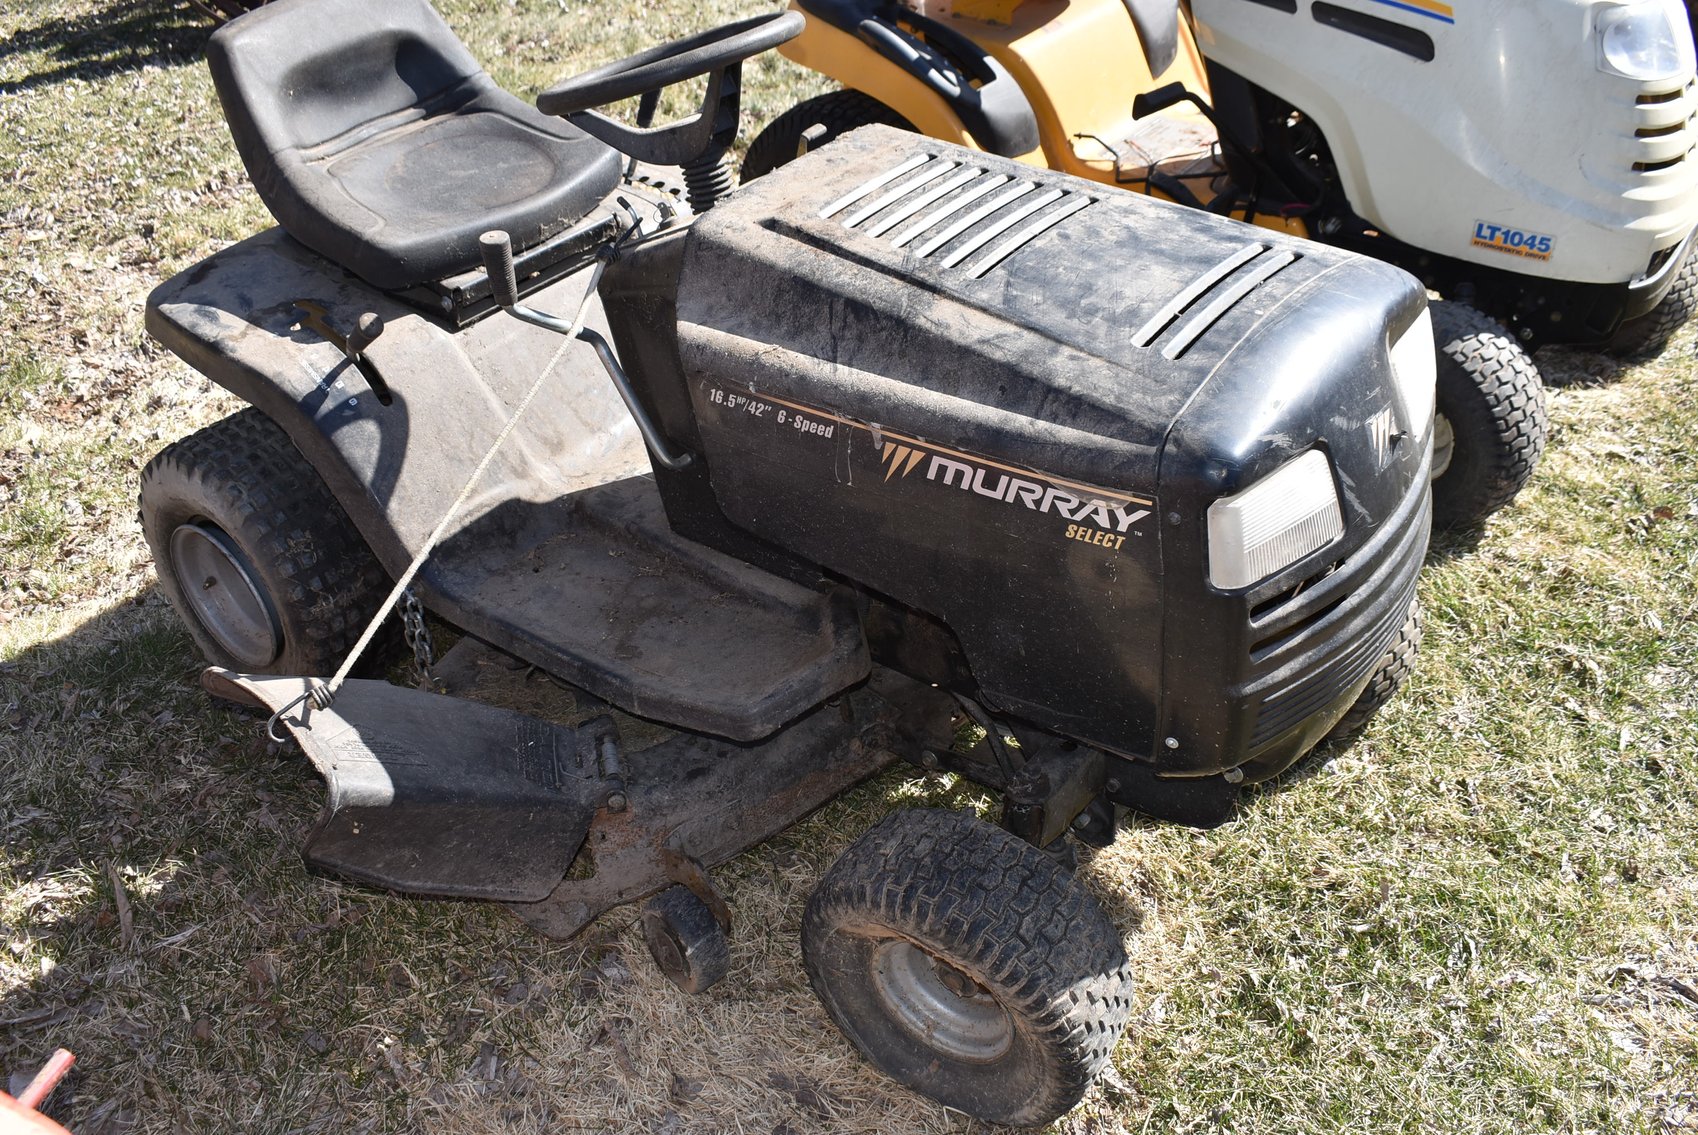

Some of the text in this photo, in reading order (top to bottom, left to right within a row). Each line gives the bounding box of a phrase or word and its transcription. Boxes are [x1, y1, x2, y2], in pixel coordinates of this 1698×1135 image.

[1475, 223, 1551, 253] LT1045
[926, 455, 1151, 533] MURRAY
[1065, 524, 1126, 550] SELECT
